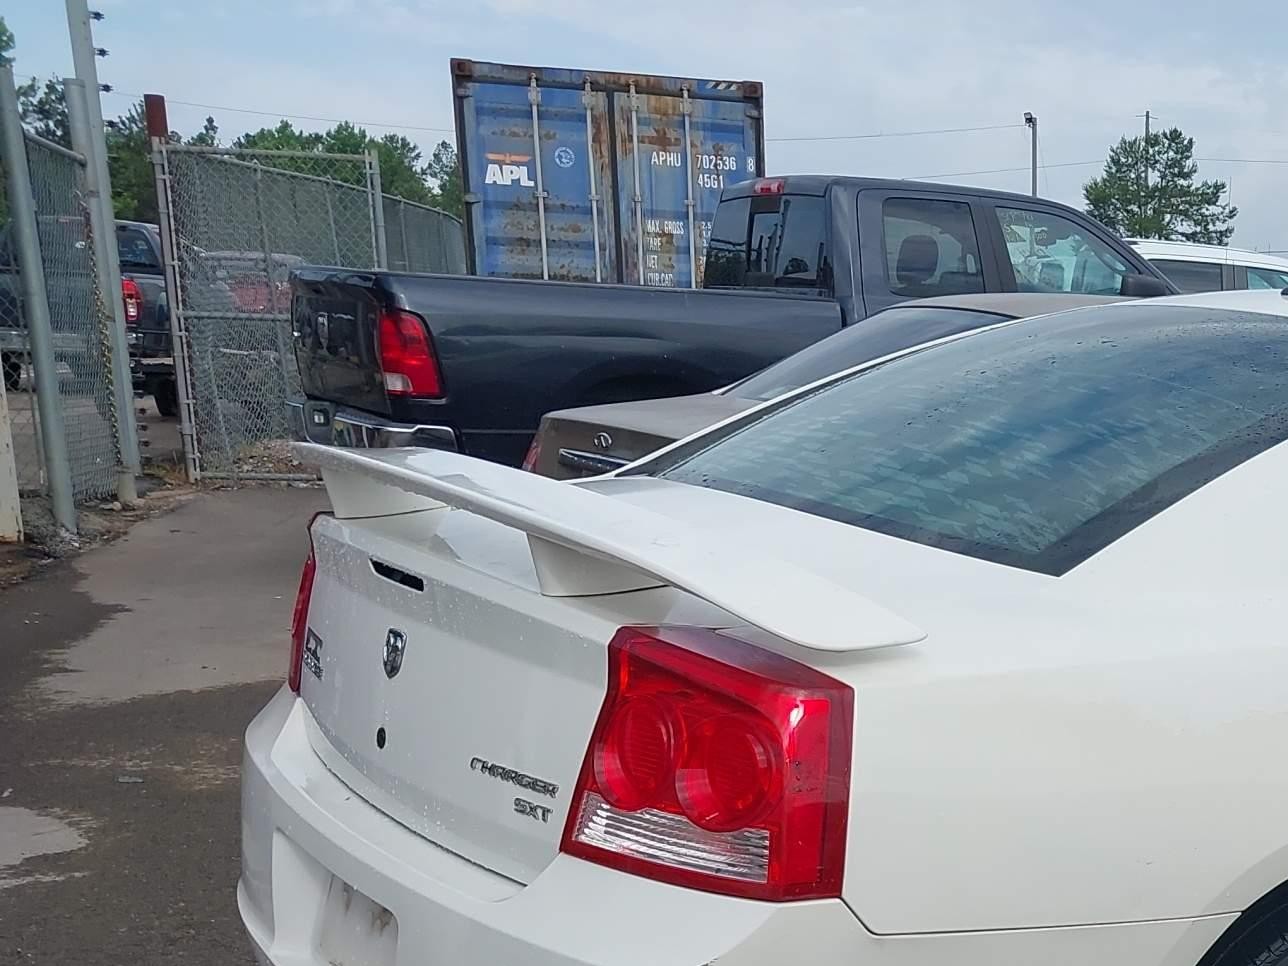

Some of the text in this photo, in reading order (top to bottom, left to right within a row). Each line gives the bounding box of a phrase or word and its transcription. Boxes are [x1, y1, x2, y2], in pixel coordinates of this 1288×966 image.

[651, 151, 754, 172] APHU 702536 8
[485, 163, 535, 187] APL
[697, 173, 724, 189] 45G1
[664, 220, 685, 235] GROSS
[470, 756, 560, 799] CHARGER
[513, 797, 553, 824] SXT
